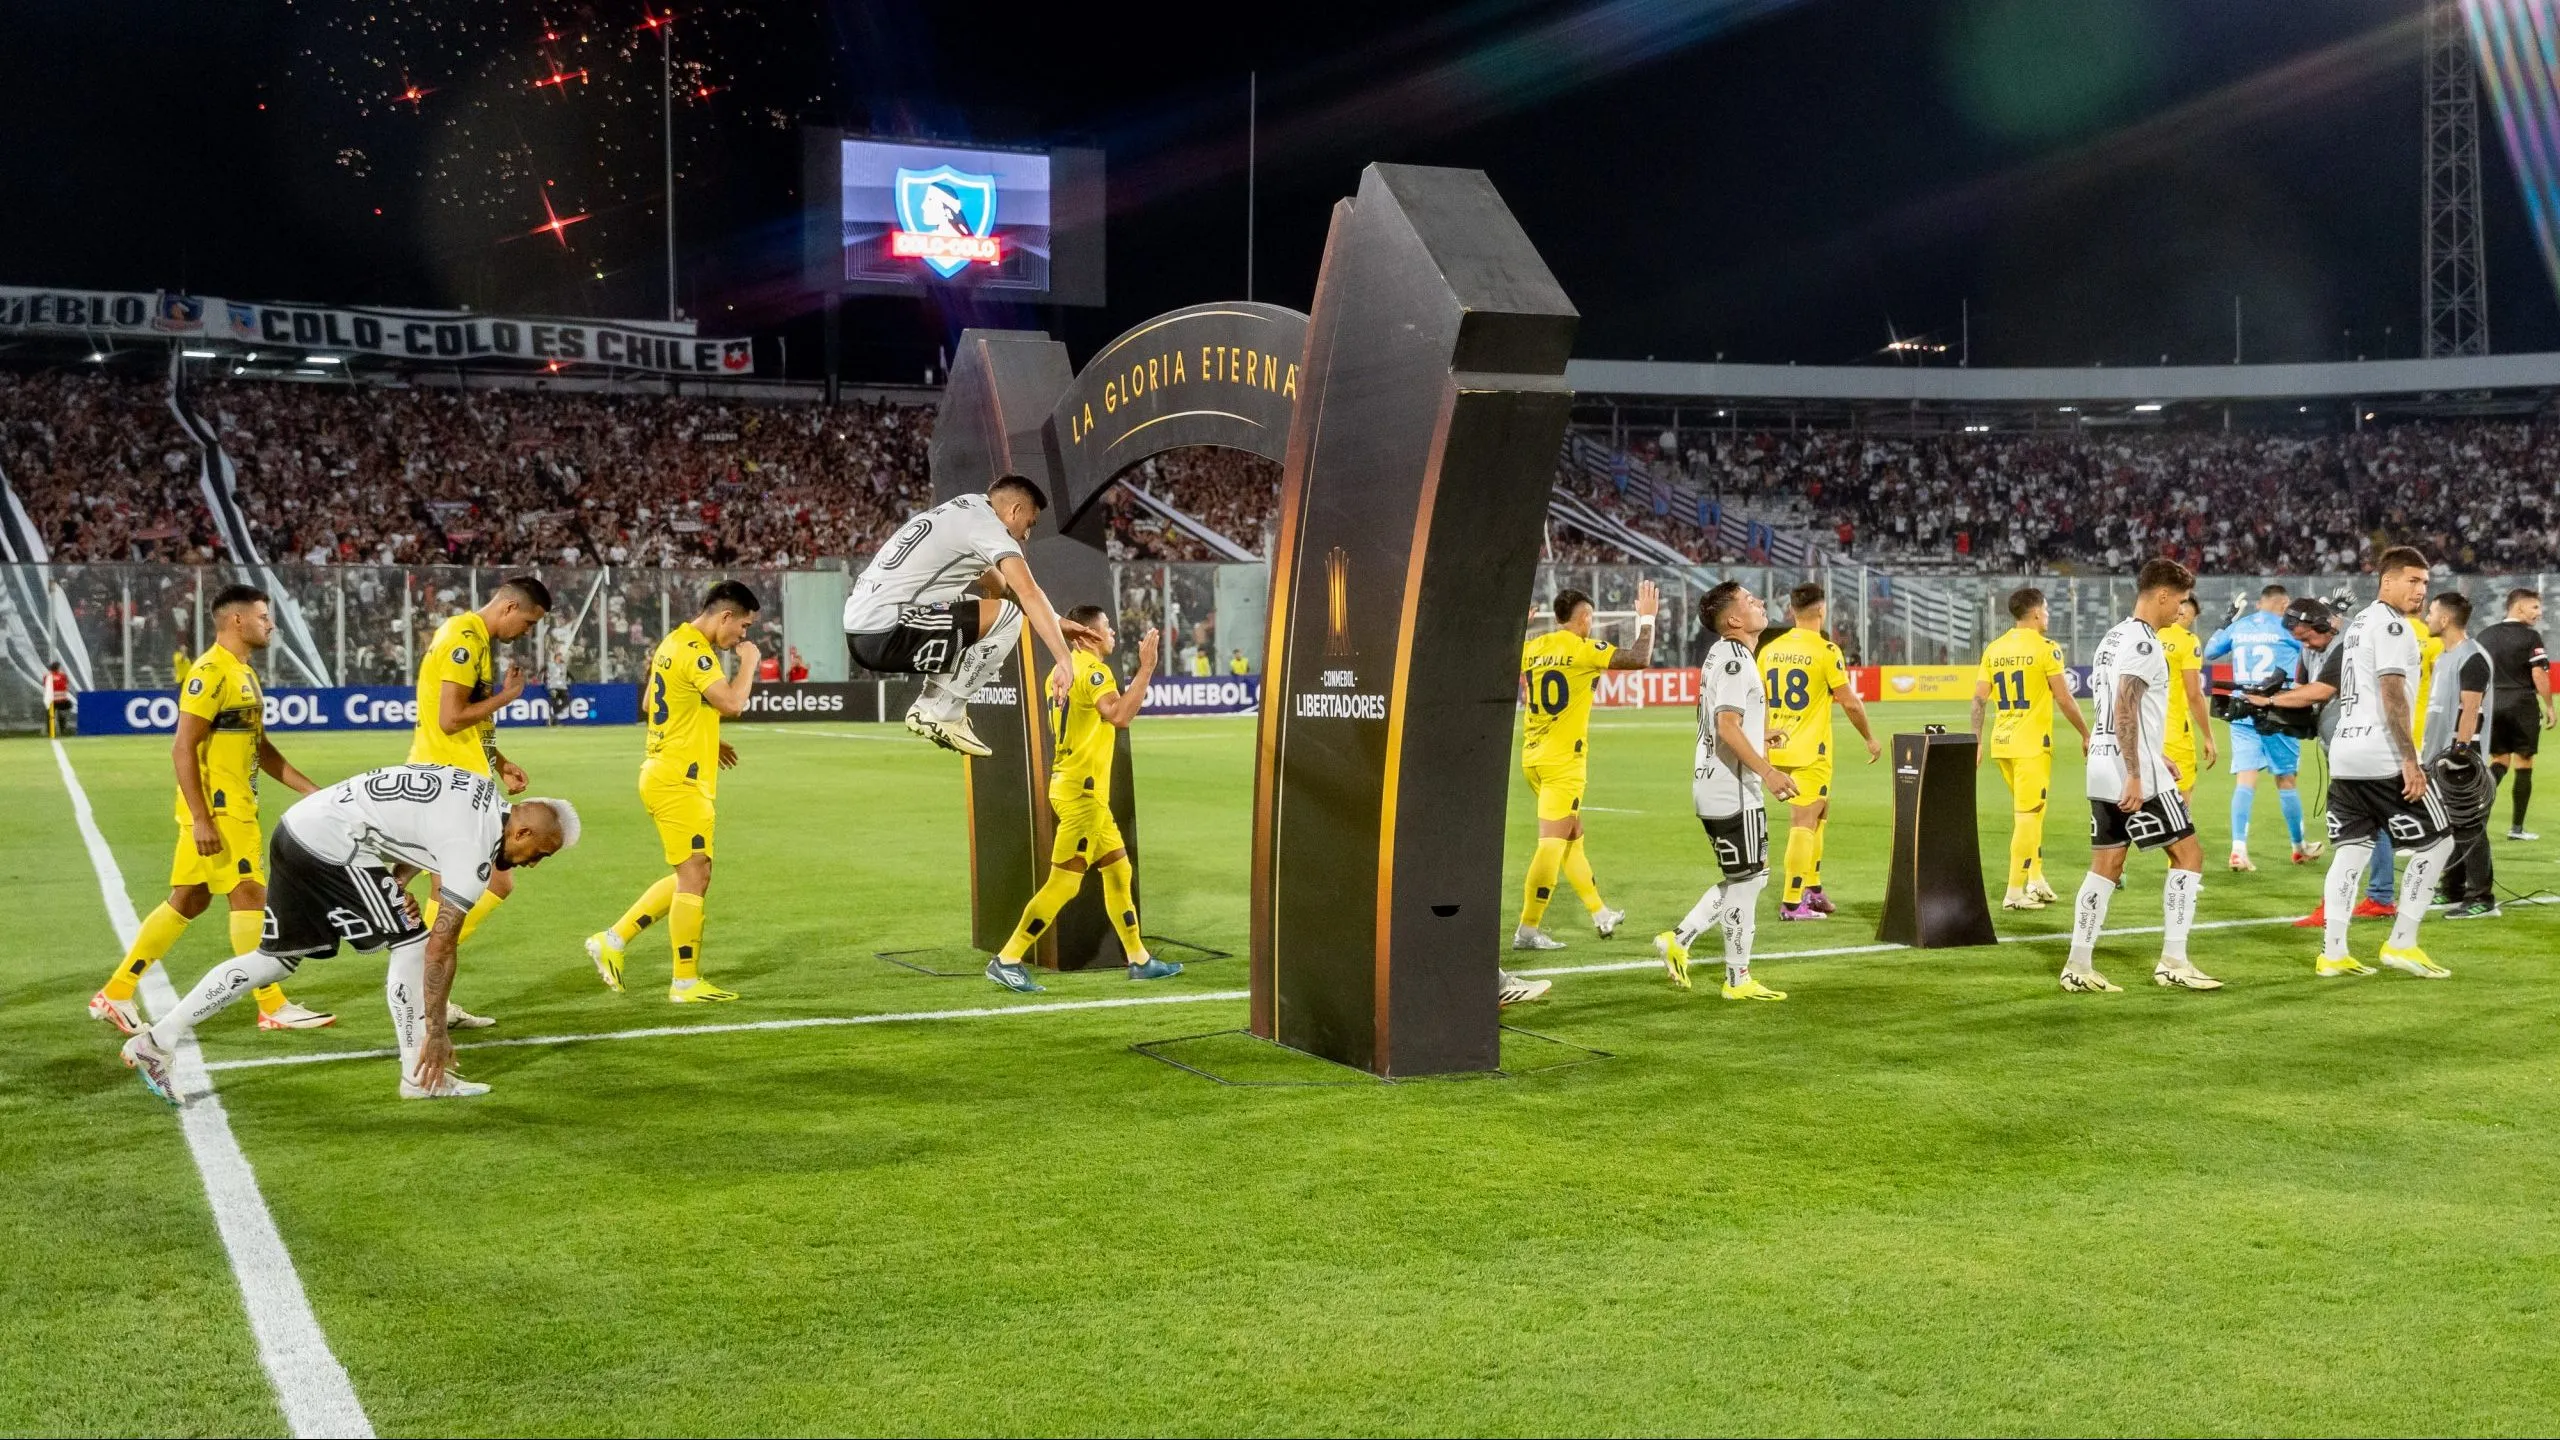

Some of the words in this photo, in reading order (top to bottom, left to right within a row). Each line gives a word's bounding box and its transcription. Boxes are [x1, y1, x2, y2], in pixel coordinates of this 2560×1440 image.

[261, 309, 520, 356] COLO-COLO
[531, 325, 585, 359] ES
[597, 331, 719, 373] CHILE
[1072, 403, 1094, 444] LA
[1105, 351, 1186, 413] GLORIA
[1202, 346, 1297, 401] ETERNA
[878, 519, 933, 570] 9
[1773, 653, 1812, 666] ROMERO
[1994, 656, 2034, 667] BONETTO
[2233, 644, 2274, 683] 12
[1125, 683, 1254, 707] ONMEBOL
[1323, 671, 1355, 688] CONMEBOL
[1526, 670, 1569, 715] 10
[1767, 668, 1810, 711] 18
[1993, 669, 2030, 710] 11
[2340, 658, 2359, 717] 4
[125, 695, 328, 728] COBOL
[345, 694, 417, 723] Cree
[1296, 693, 1386, 720] LIBERTADORES
[2167, 893, 2175, 911] pago
[2177, 893, 2186, 925] mercado
[2078, 912, 2088, 930] pago
[2085, 912, 2096, 943] mercado
[205, 981, 226, 1000] pago
